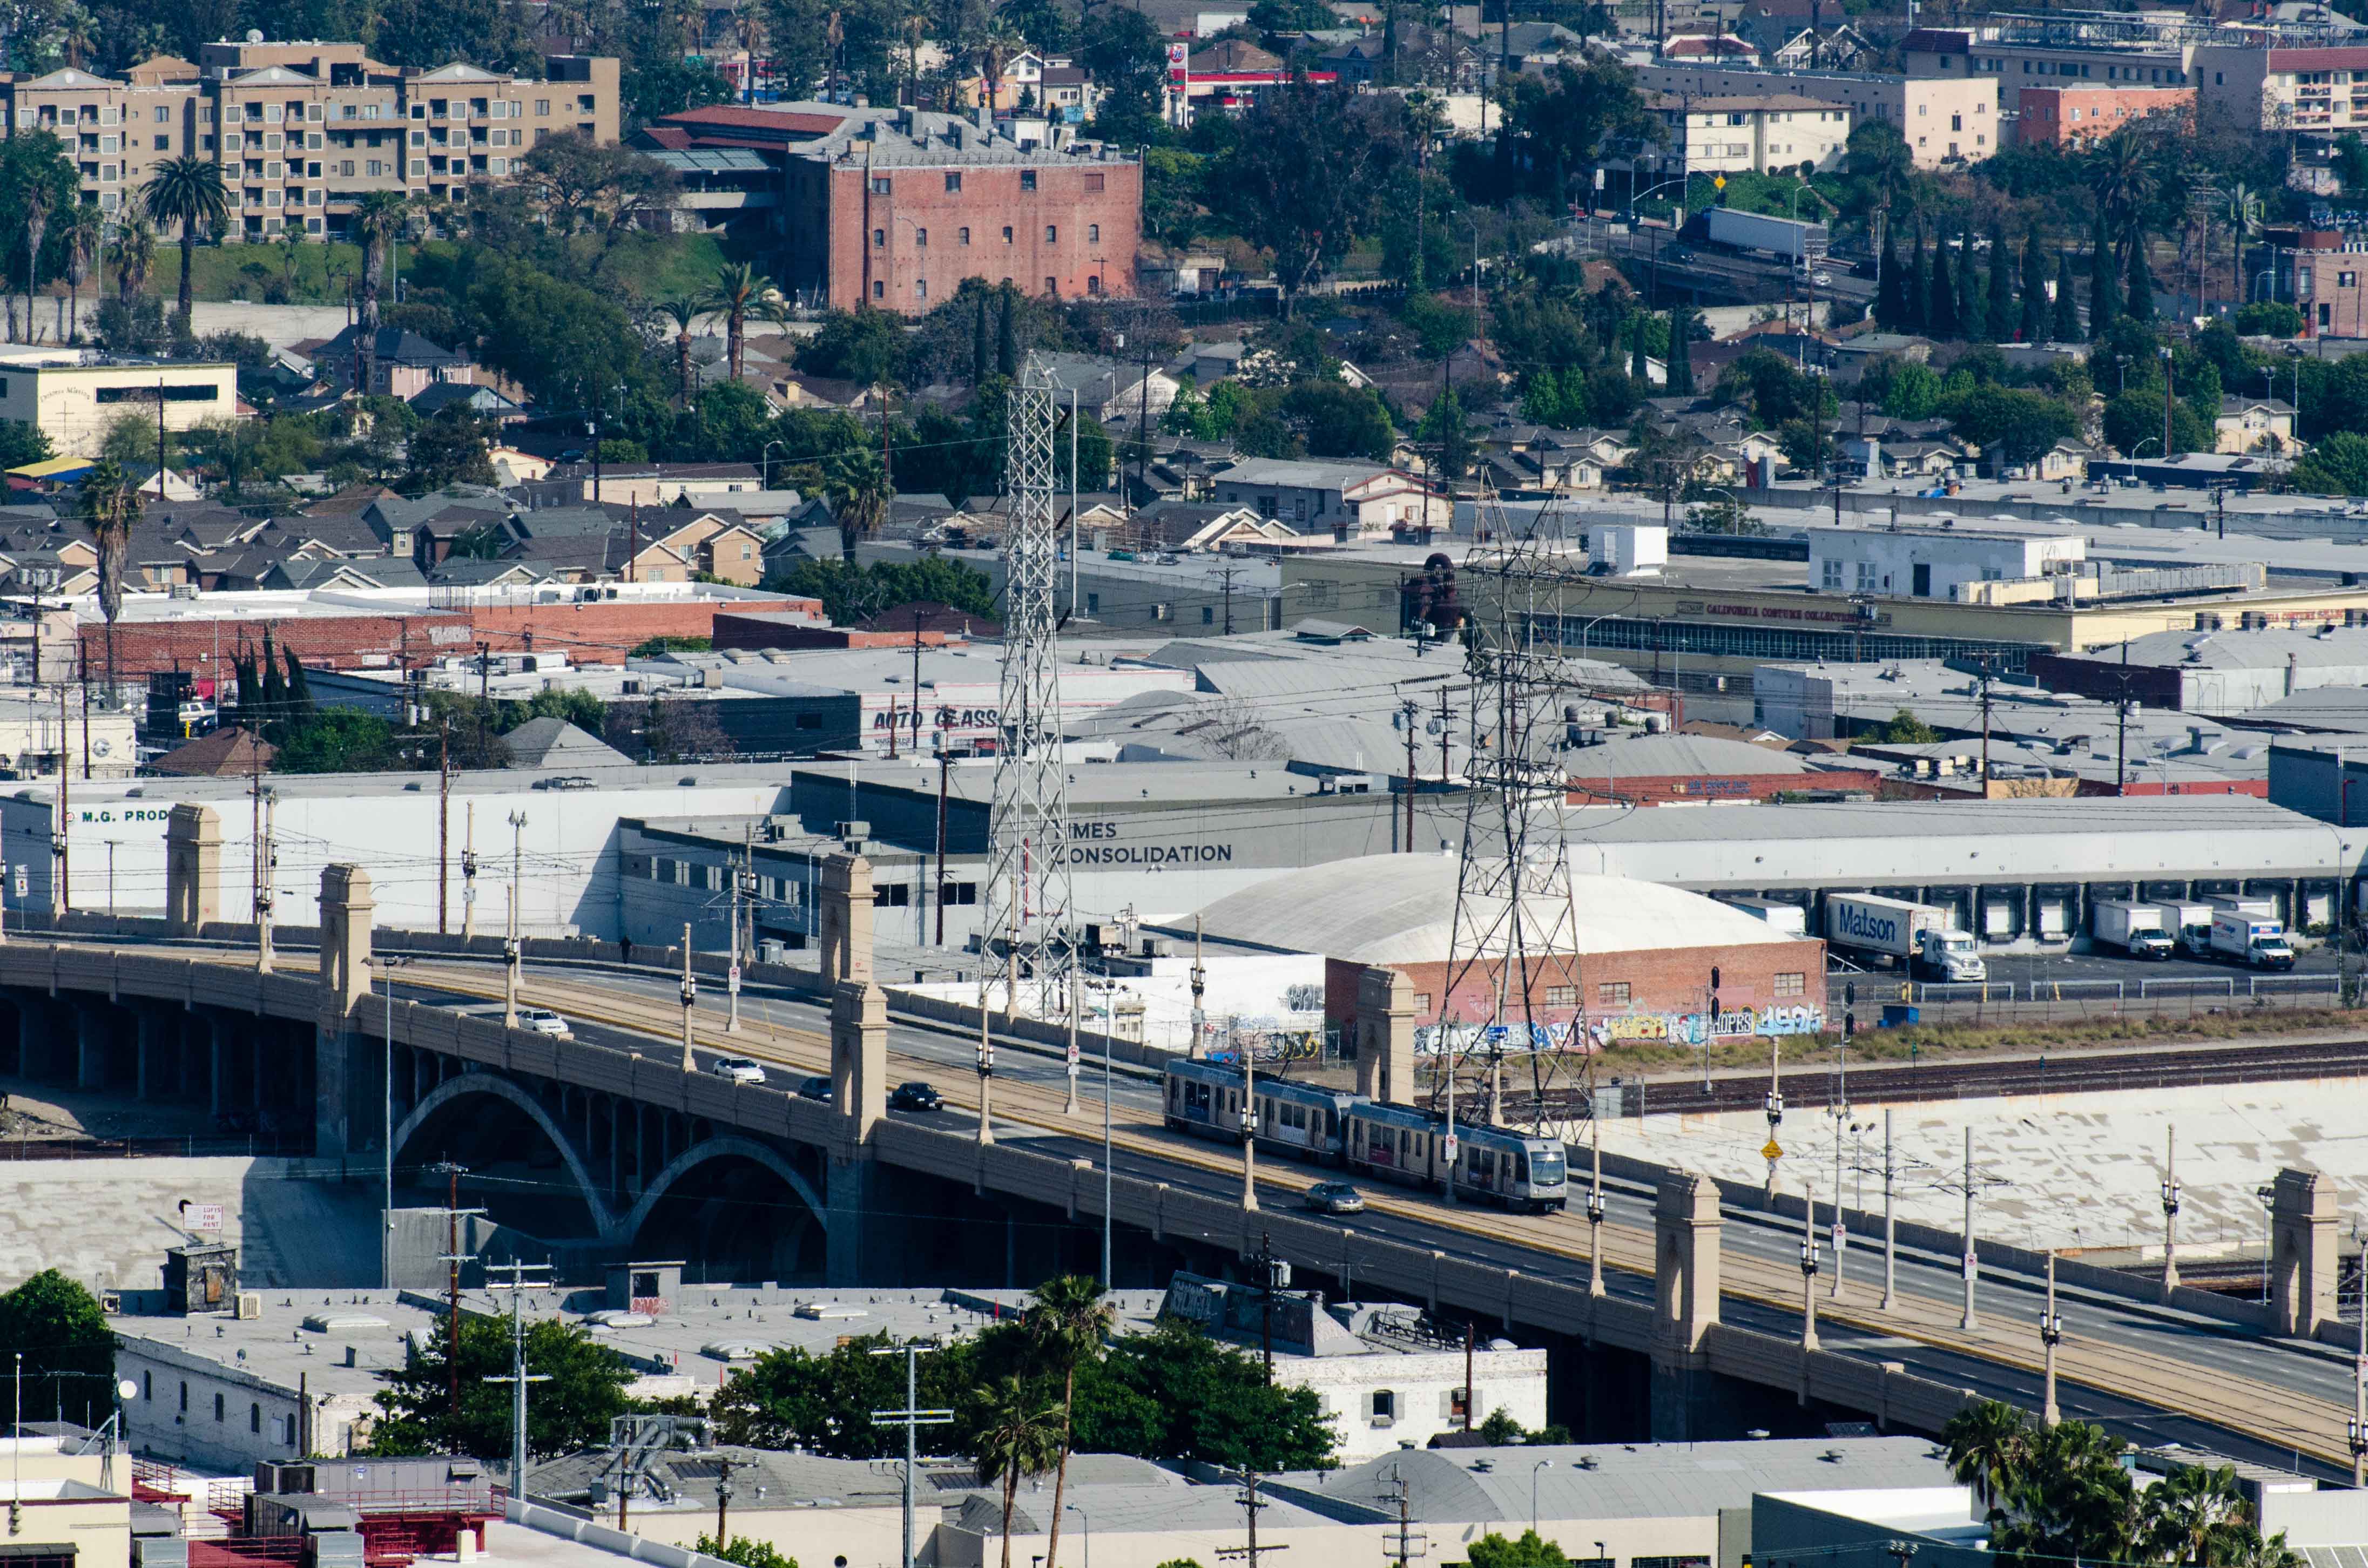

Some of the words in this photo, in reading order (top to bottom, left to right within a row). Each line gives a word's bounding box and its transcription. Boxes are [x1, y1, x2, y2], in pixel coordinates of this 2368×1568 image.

[1173, 50, 1182, 59] 76
[874, 711, 923, 729] AUTO
[82, 811, 116, 822] M.G.
[1052, 819, 1116, 840] TIMES
[1051, 843, 1231, 864] CONSOLIDATION
[1840, 903, 1895, 942] Matson
